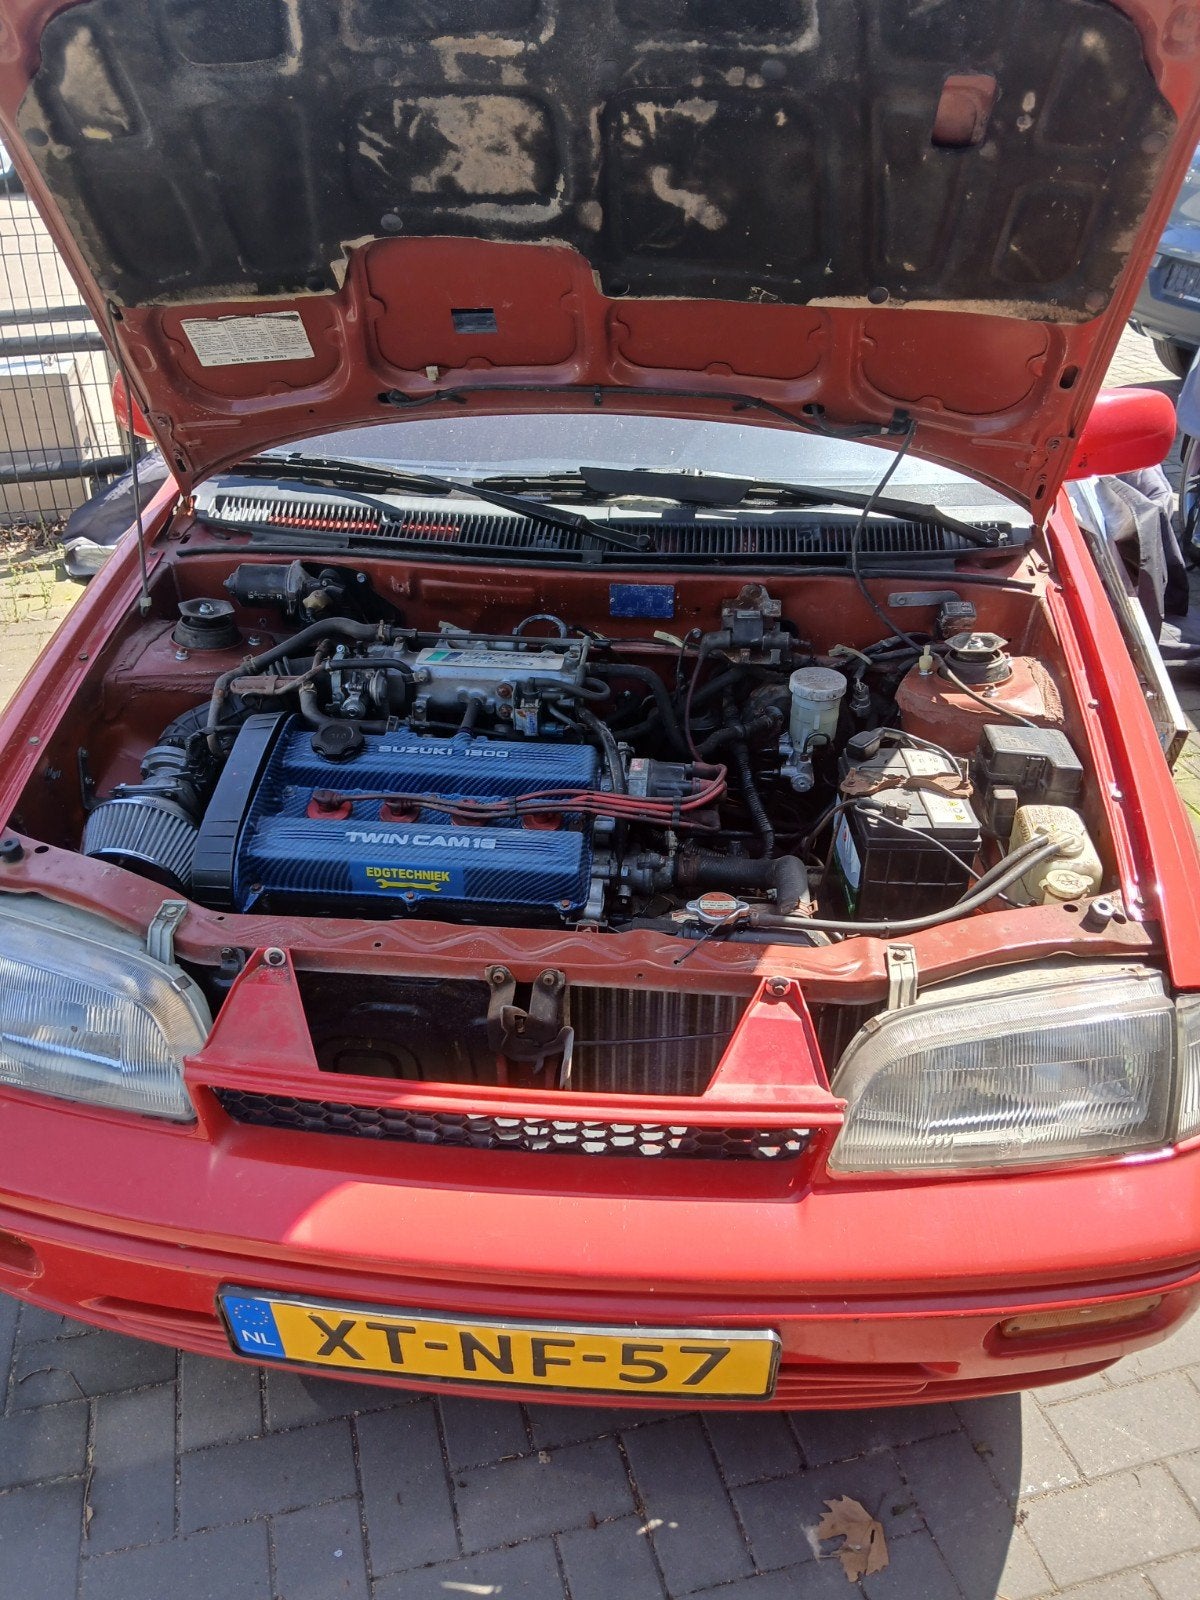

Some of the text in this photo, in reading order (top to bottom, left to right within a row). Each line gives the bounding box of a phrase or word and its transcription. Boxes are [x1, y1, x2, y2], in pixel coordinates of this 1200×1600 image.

[378, 745, 509, 758] SUZUKI 1300
[345, 831, 497, 849] TWIN CAM 16
[366, 866, 450, 882] EDGTECHNIEK
[241, 1328, 276, 1347] NL
[307, 1314, 732, 1386] XT-NF-57
